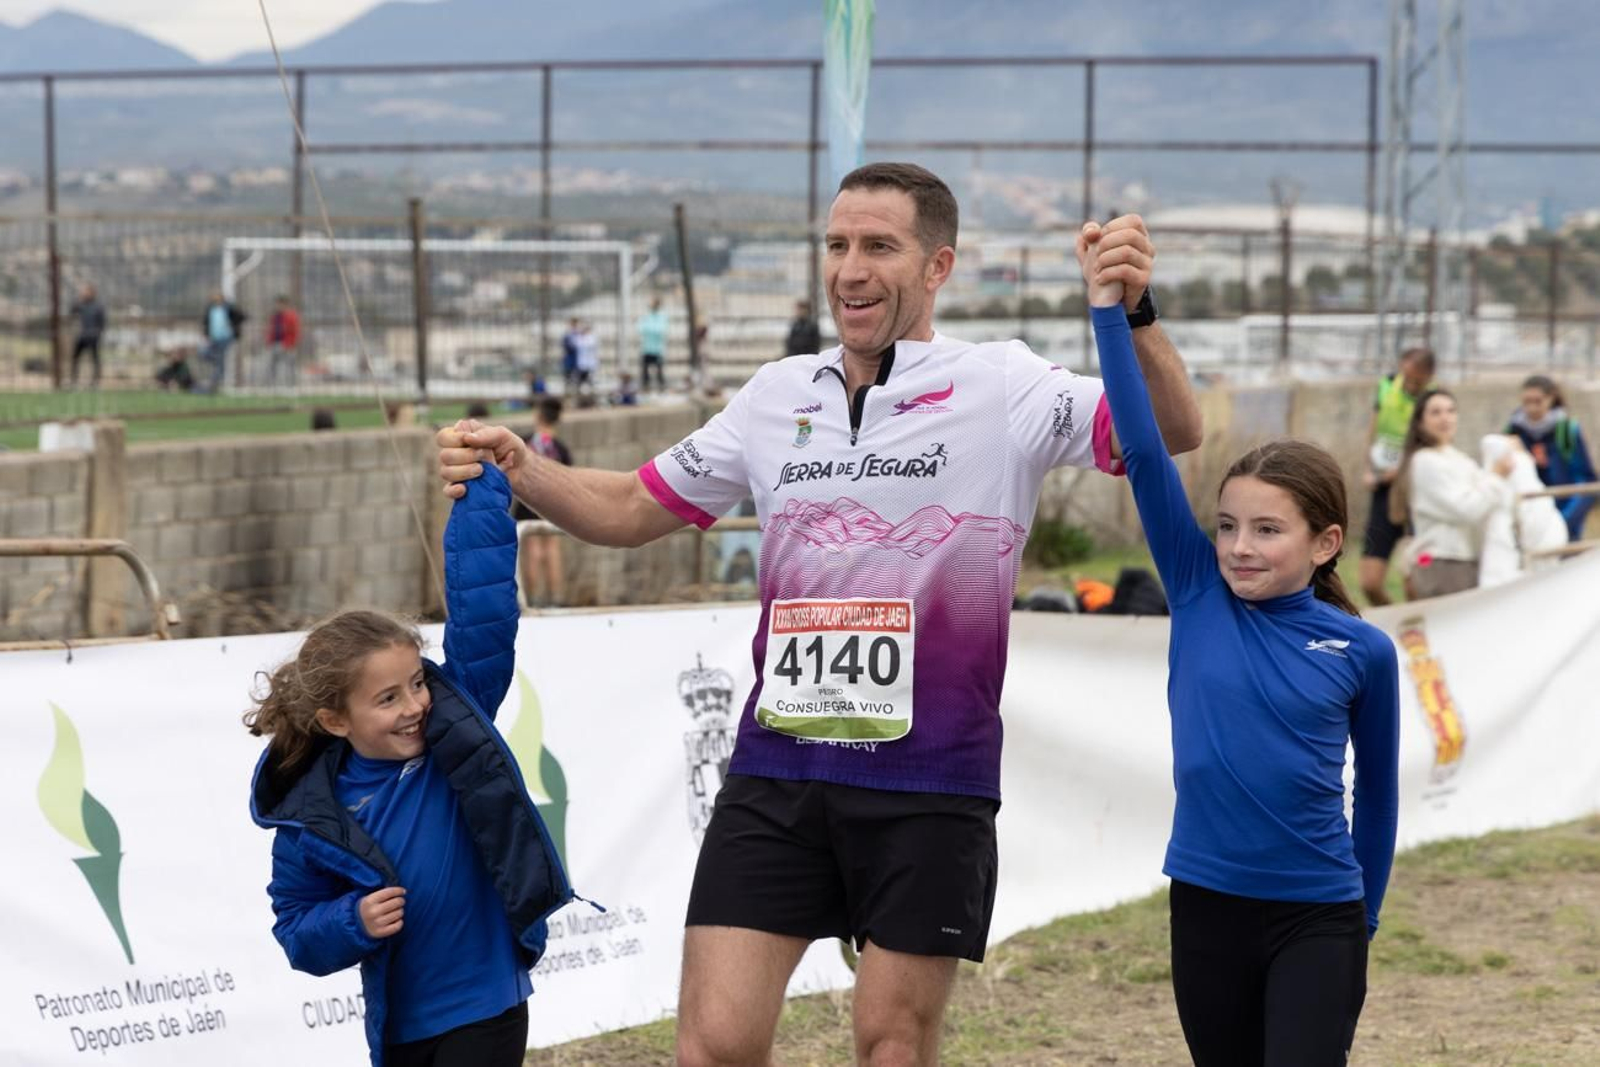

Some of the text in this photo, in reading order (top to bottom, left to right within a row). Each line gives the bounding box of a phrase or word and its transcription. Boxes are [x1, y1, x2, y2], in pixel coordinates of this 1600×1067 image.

[773, 453, 938, 492] SIERRA DE SEGURA
[791, 606, 810, 629] CROSS
[810, 606, 842, 628] POPULAR
[843, 606, 873, 627] CIUDAD
[873, 606, 885, 627] DE
[773, 635, 901, 686] 4140
[776, 699, 895, 715] CONSUEGRA VIVO
[34, 967, 236, 1020] Patronato Municipal de
[70, 1003, 227, 1055] Deportes de Jaén
